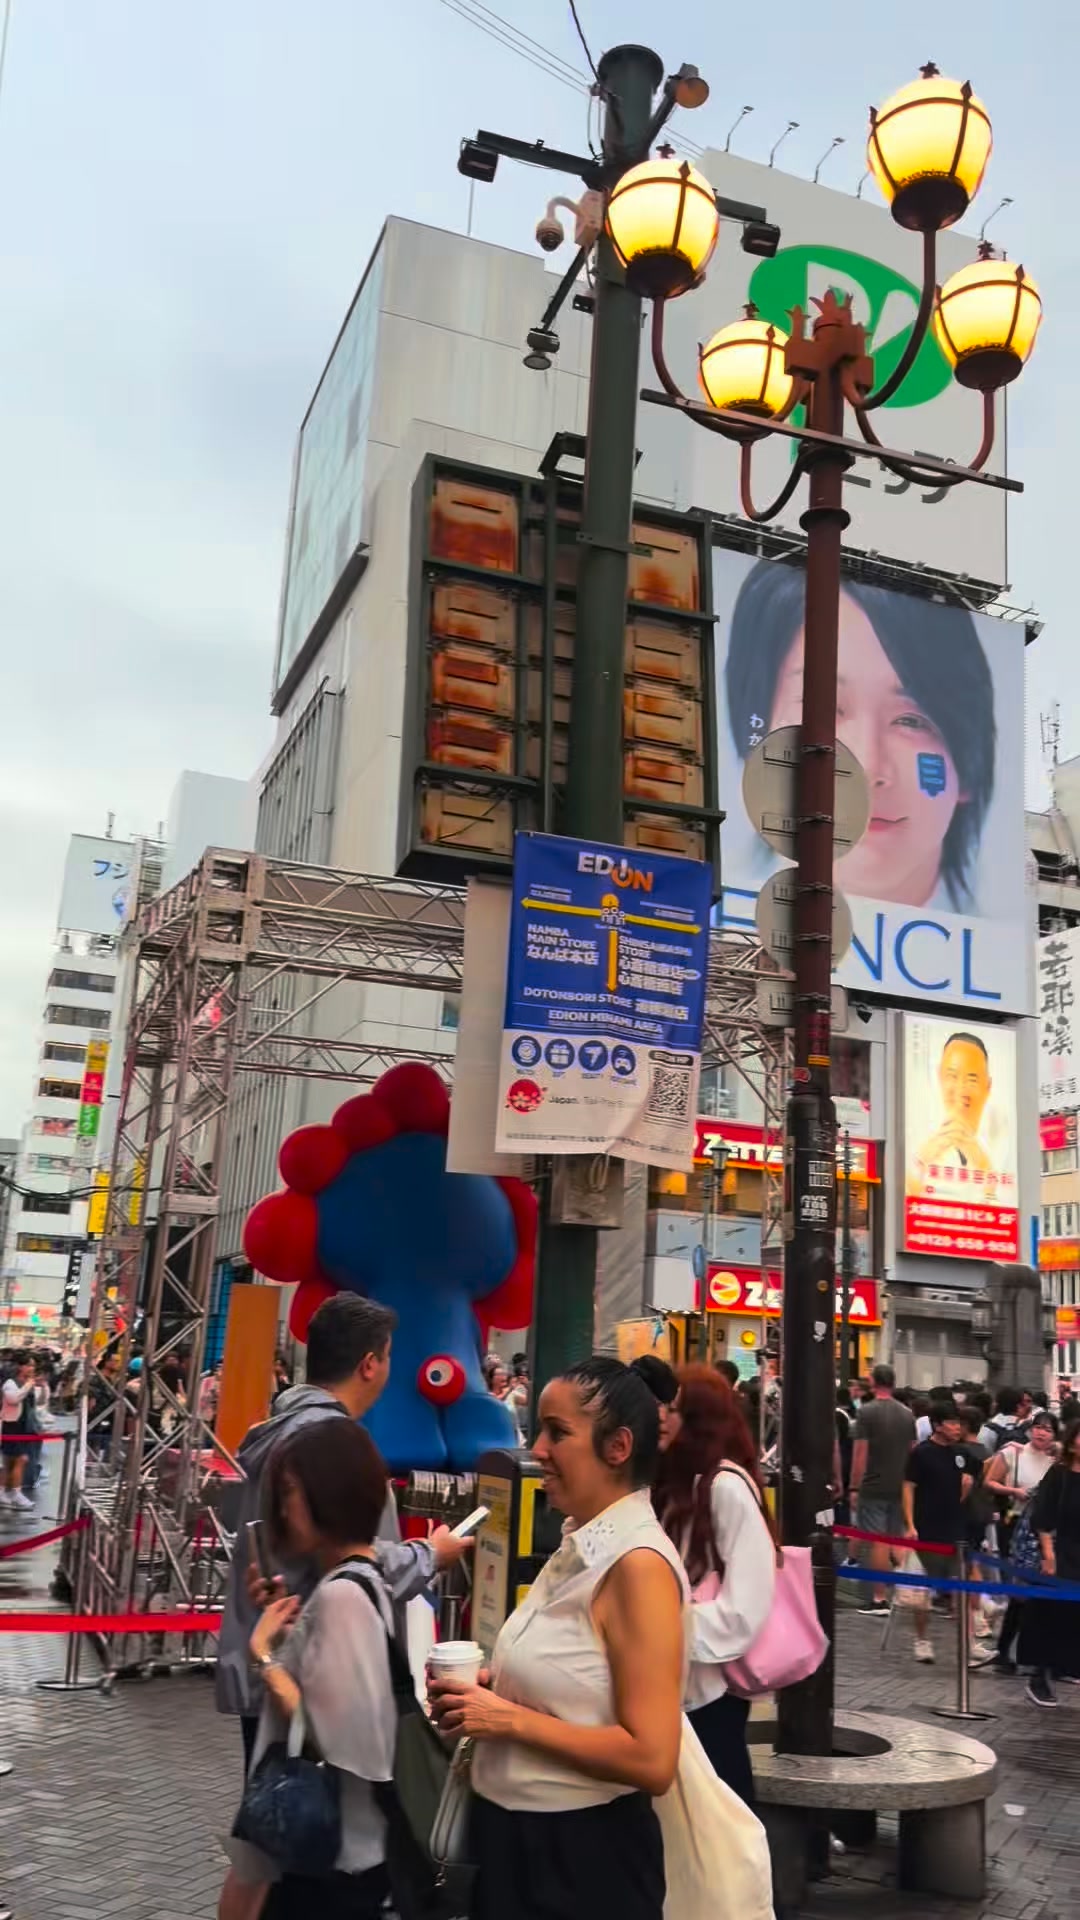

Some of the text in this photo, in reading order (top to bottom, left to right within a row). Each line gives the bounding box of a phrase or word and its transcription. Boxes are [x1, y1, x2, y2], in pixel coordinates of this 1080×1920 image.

[577, 851, 654, 893] EDION
[527, 924, 570, 937] NAMBA
[527, 933, 598, 950] MAIN STORE
[716, 885, 1001, 1001] FNCL
[618, 944, 651, 959] STORE
[523, 986, 633, 1008] DOTONBORI STORE
[548, 1009, 588, 1022] EDION
